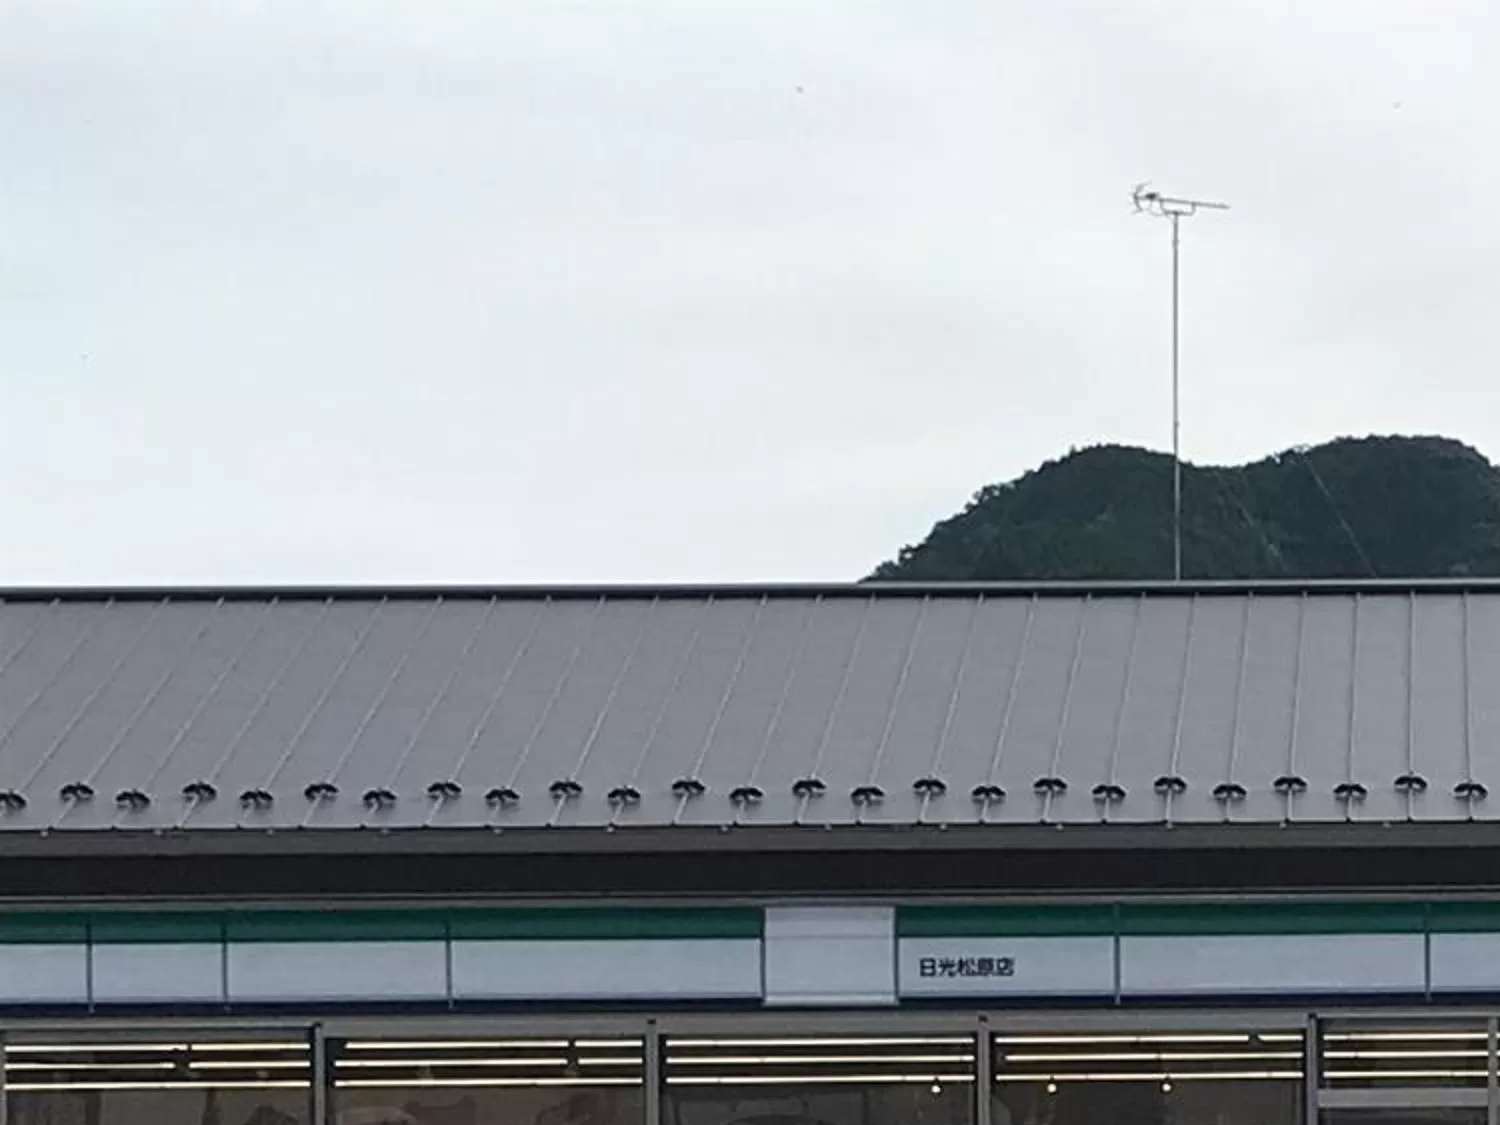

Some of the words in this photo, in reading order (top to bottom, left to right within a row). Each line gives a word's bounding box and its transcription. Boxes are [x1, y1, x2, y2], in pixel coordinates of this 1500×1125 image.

[919, 957, 1015, 977] 日光松原店
